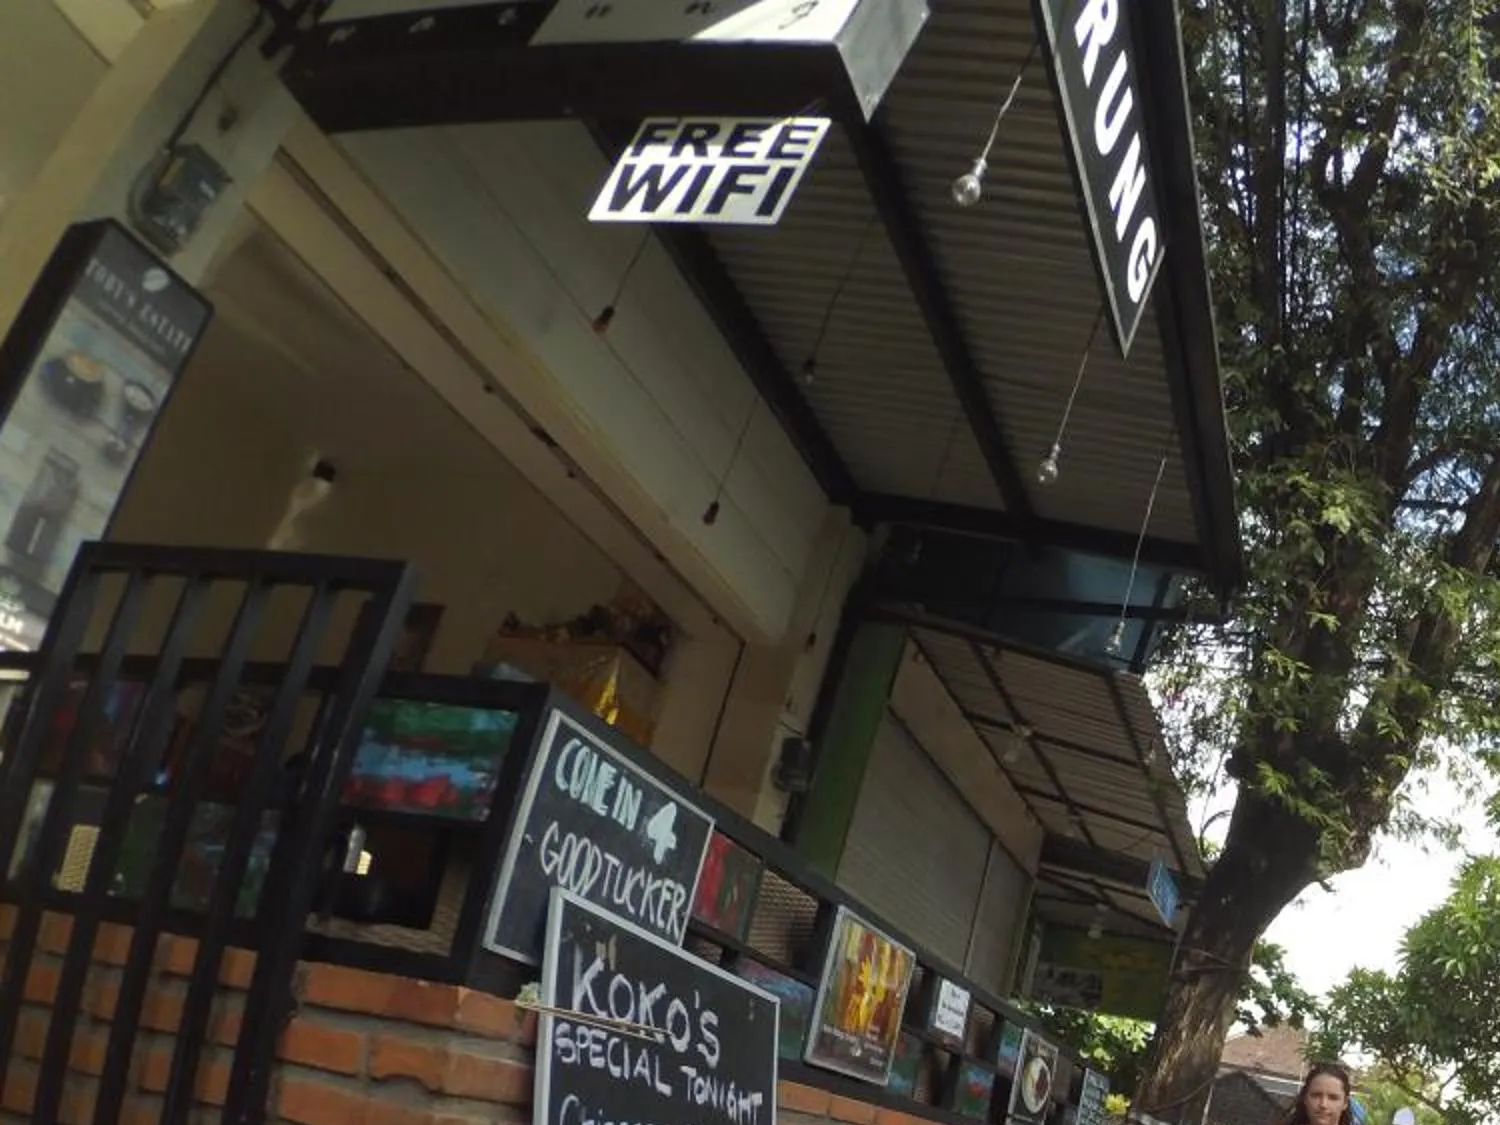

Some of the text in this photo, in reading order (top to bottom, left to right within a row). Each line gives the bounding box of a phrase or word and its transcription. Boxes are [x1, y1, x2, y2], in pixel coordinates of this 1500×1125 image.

[631, 122, 818, 160] FREE
[607, 163, 797, 217] WIFI
[611, 775, 643, 832] IN
[540, 820, 687, 939] GOOD TUCKER
[571, 941, 720, 1069] KOKO'S
[553, 1022, 672, 1098] SPECIAL
